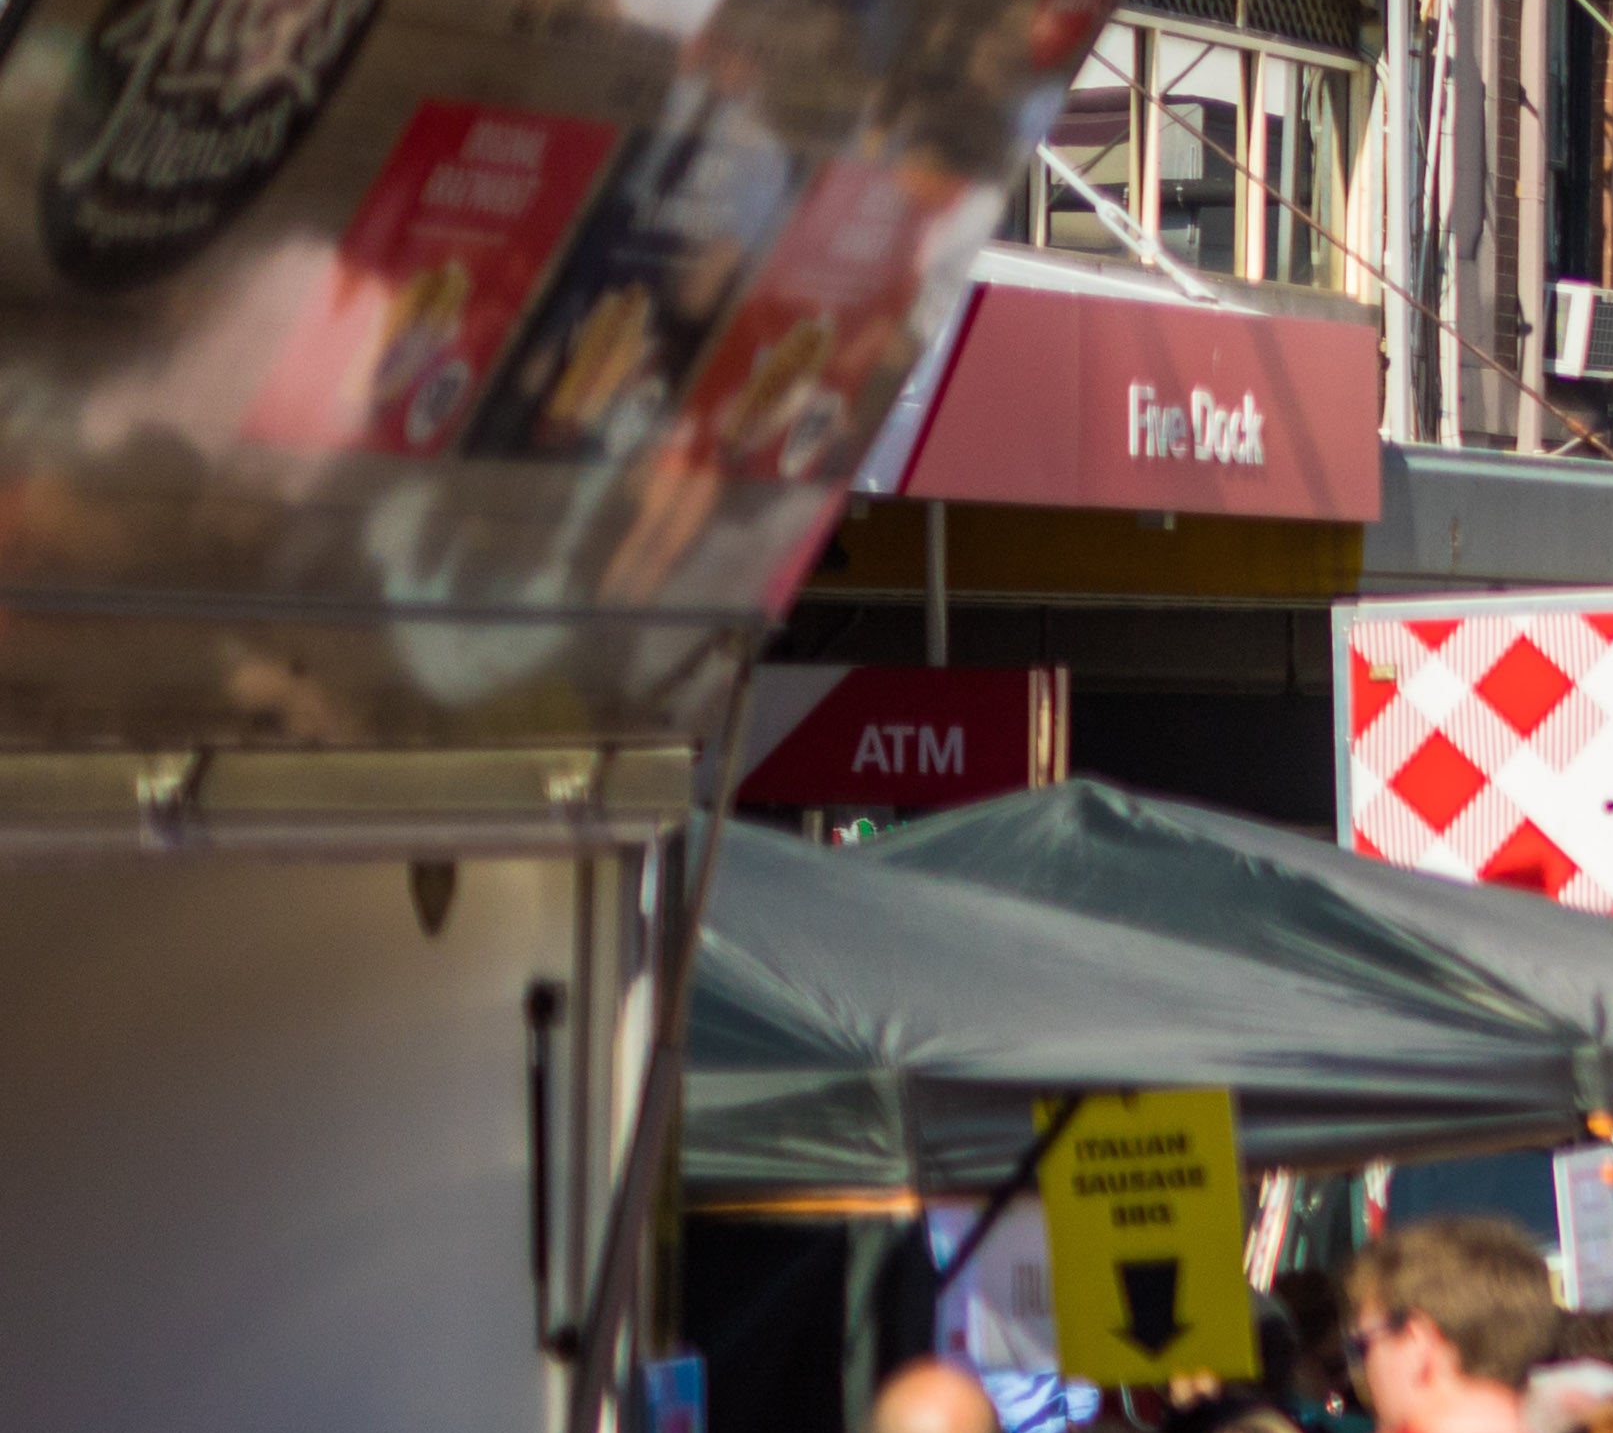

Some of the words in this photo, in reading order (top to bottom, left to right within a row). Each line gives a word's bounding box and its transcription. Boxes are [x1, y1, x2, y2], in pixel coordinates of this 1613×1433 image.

[1128, 381, 1187, 459] Five
[1191, 386, 1263, 465] Dock
[851, 724, 965, 775] ATM
[1075, 1131, 1190, 1160] ITALIAN
